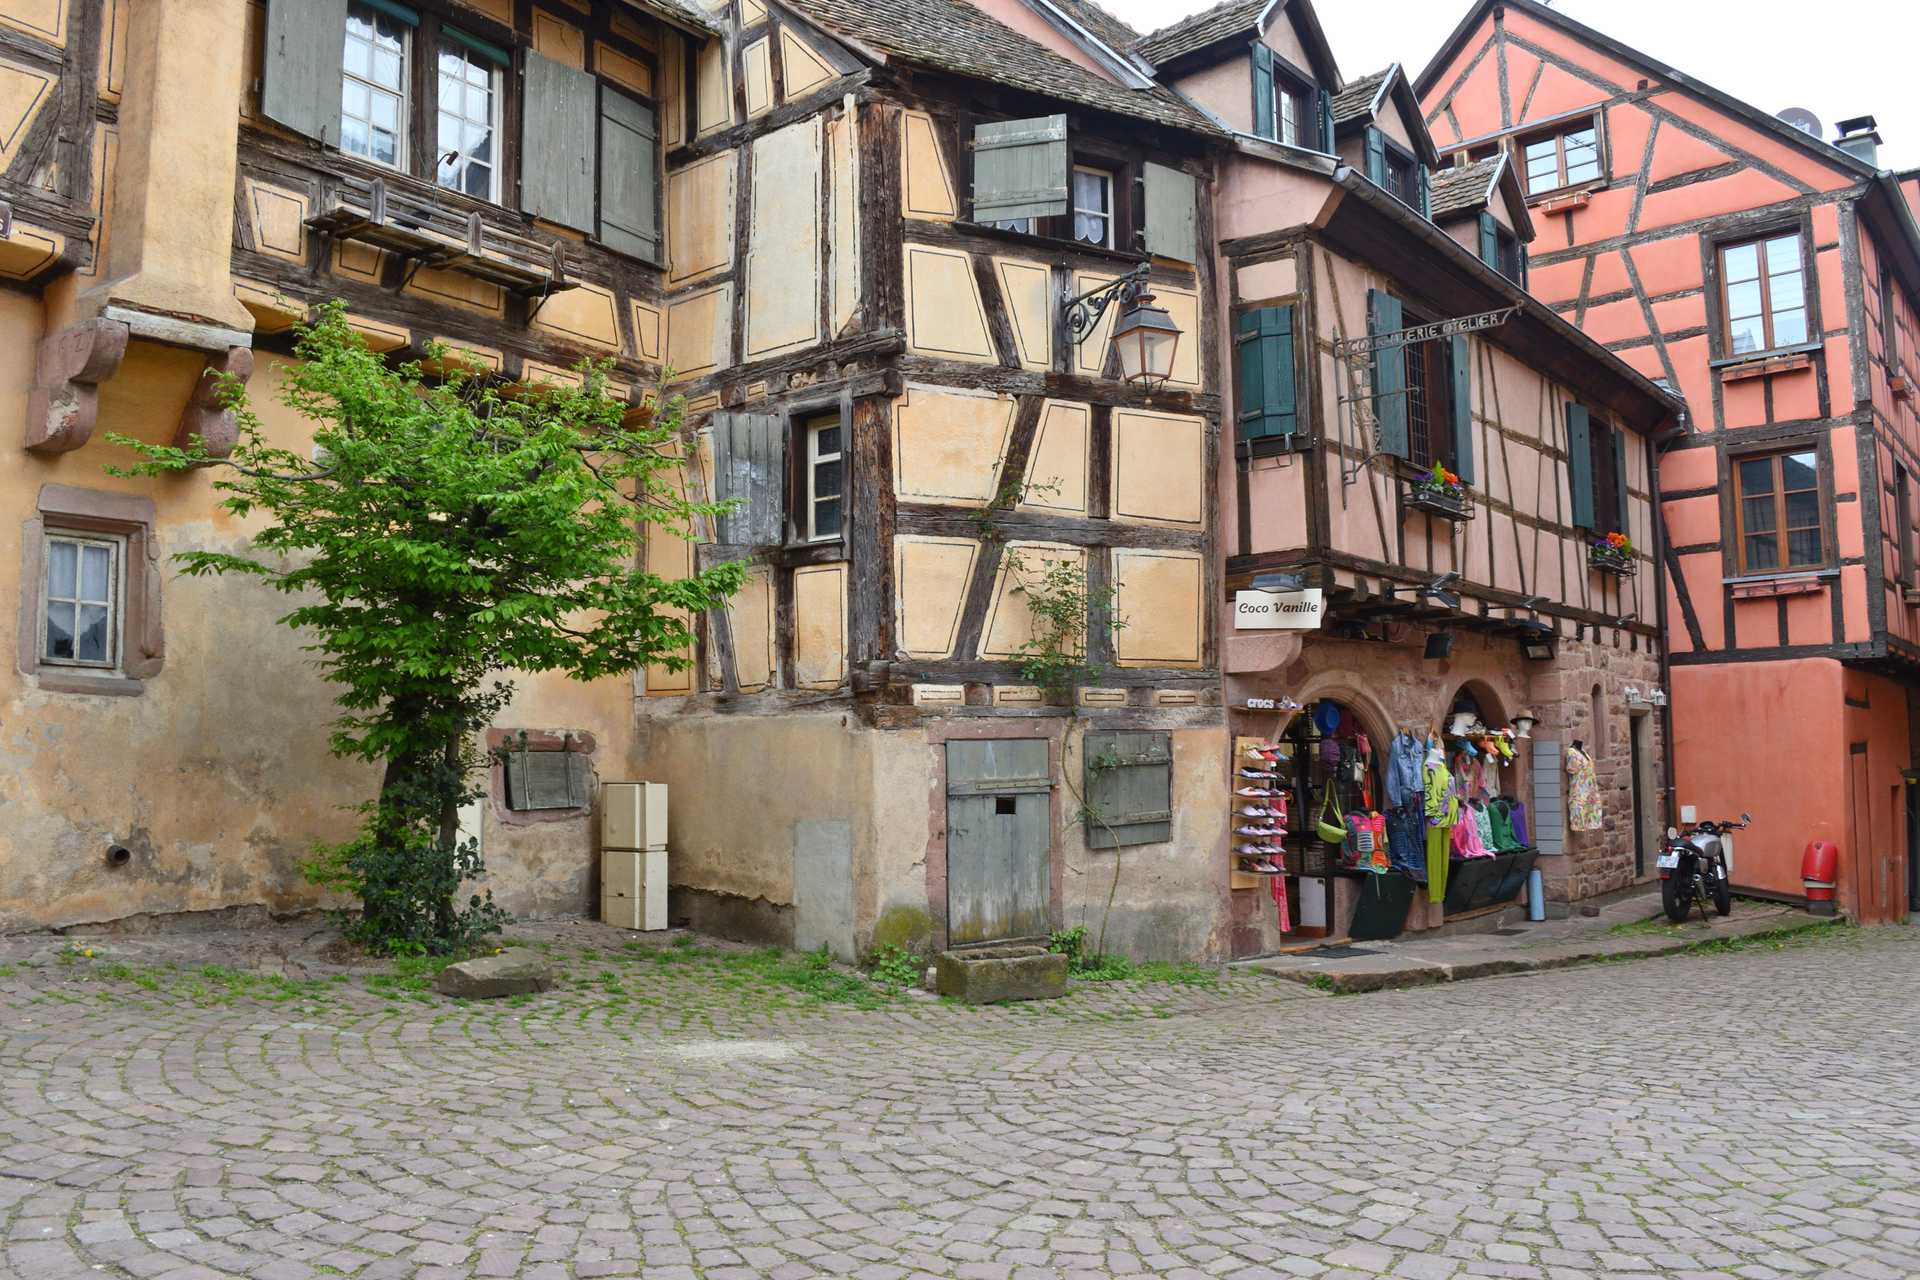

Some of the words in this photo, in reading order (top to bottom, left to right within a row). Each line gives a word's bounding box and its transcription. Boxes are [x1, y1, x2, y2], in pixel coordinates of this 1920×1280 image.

[1239, 602, 1269, 614] Coco
[1273, 600, 1318, 613] Vanille
[1247, 698, 1275, 709] crocs
